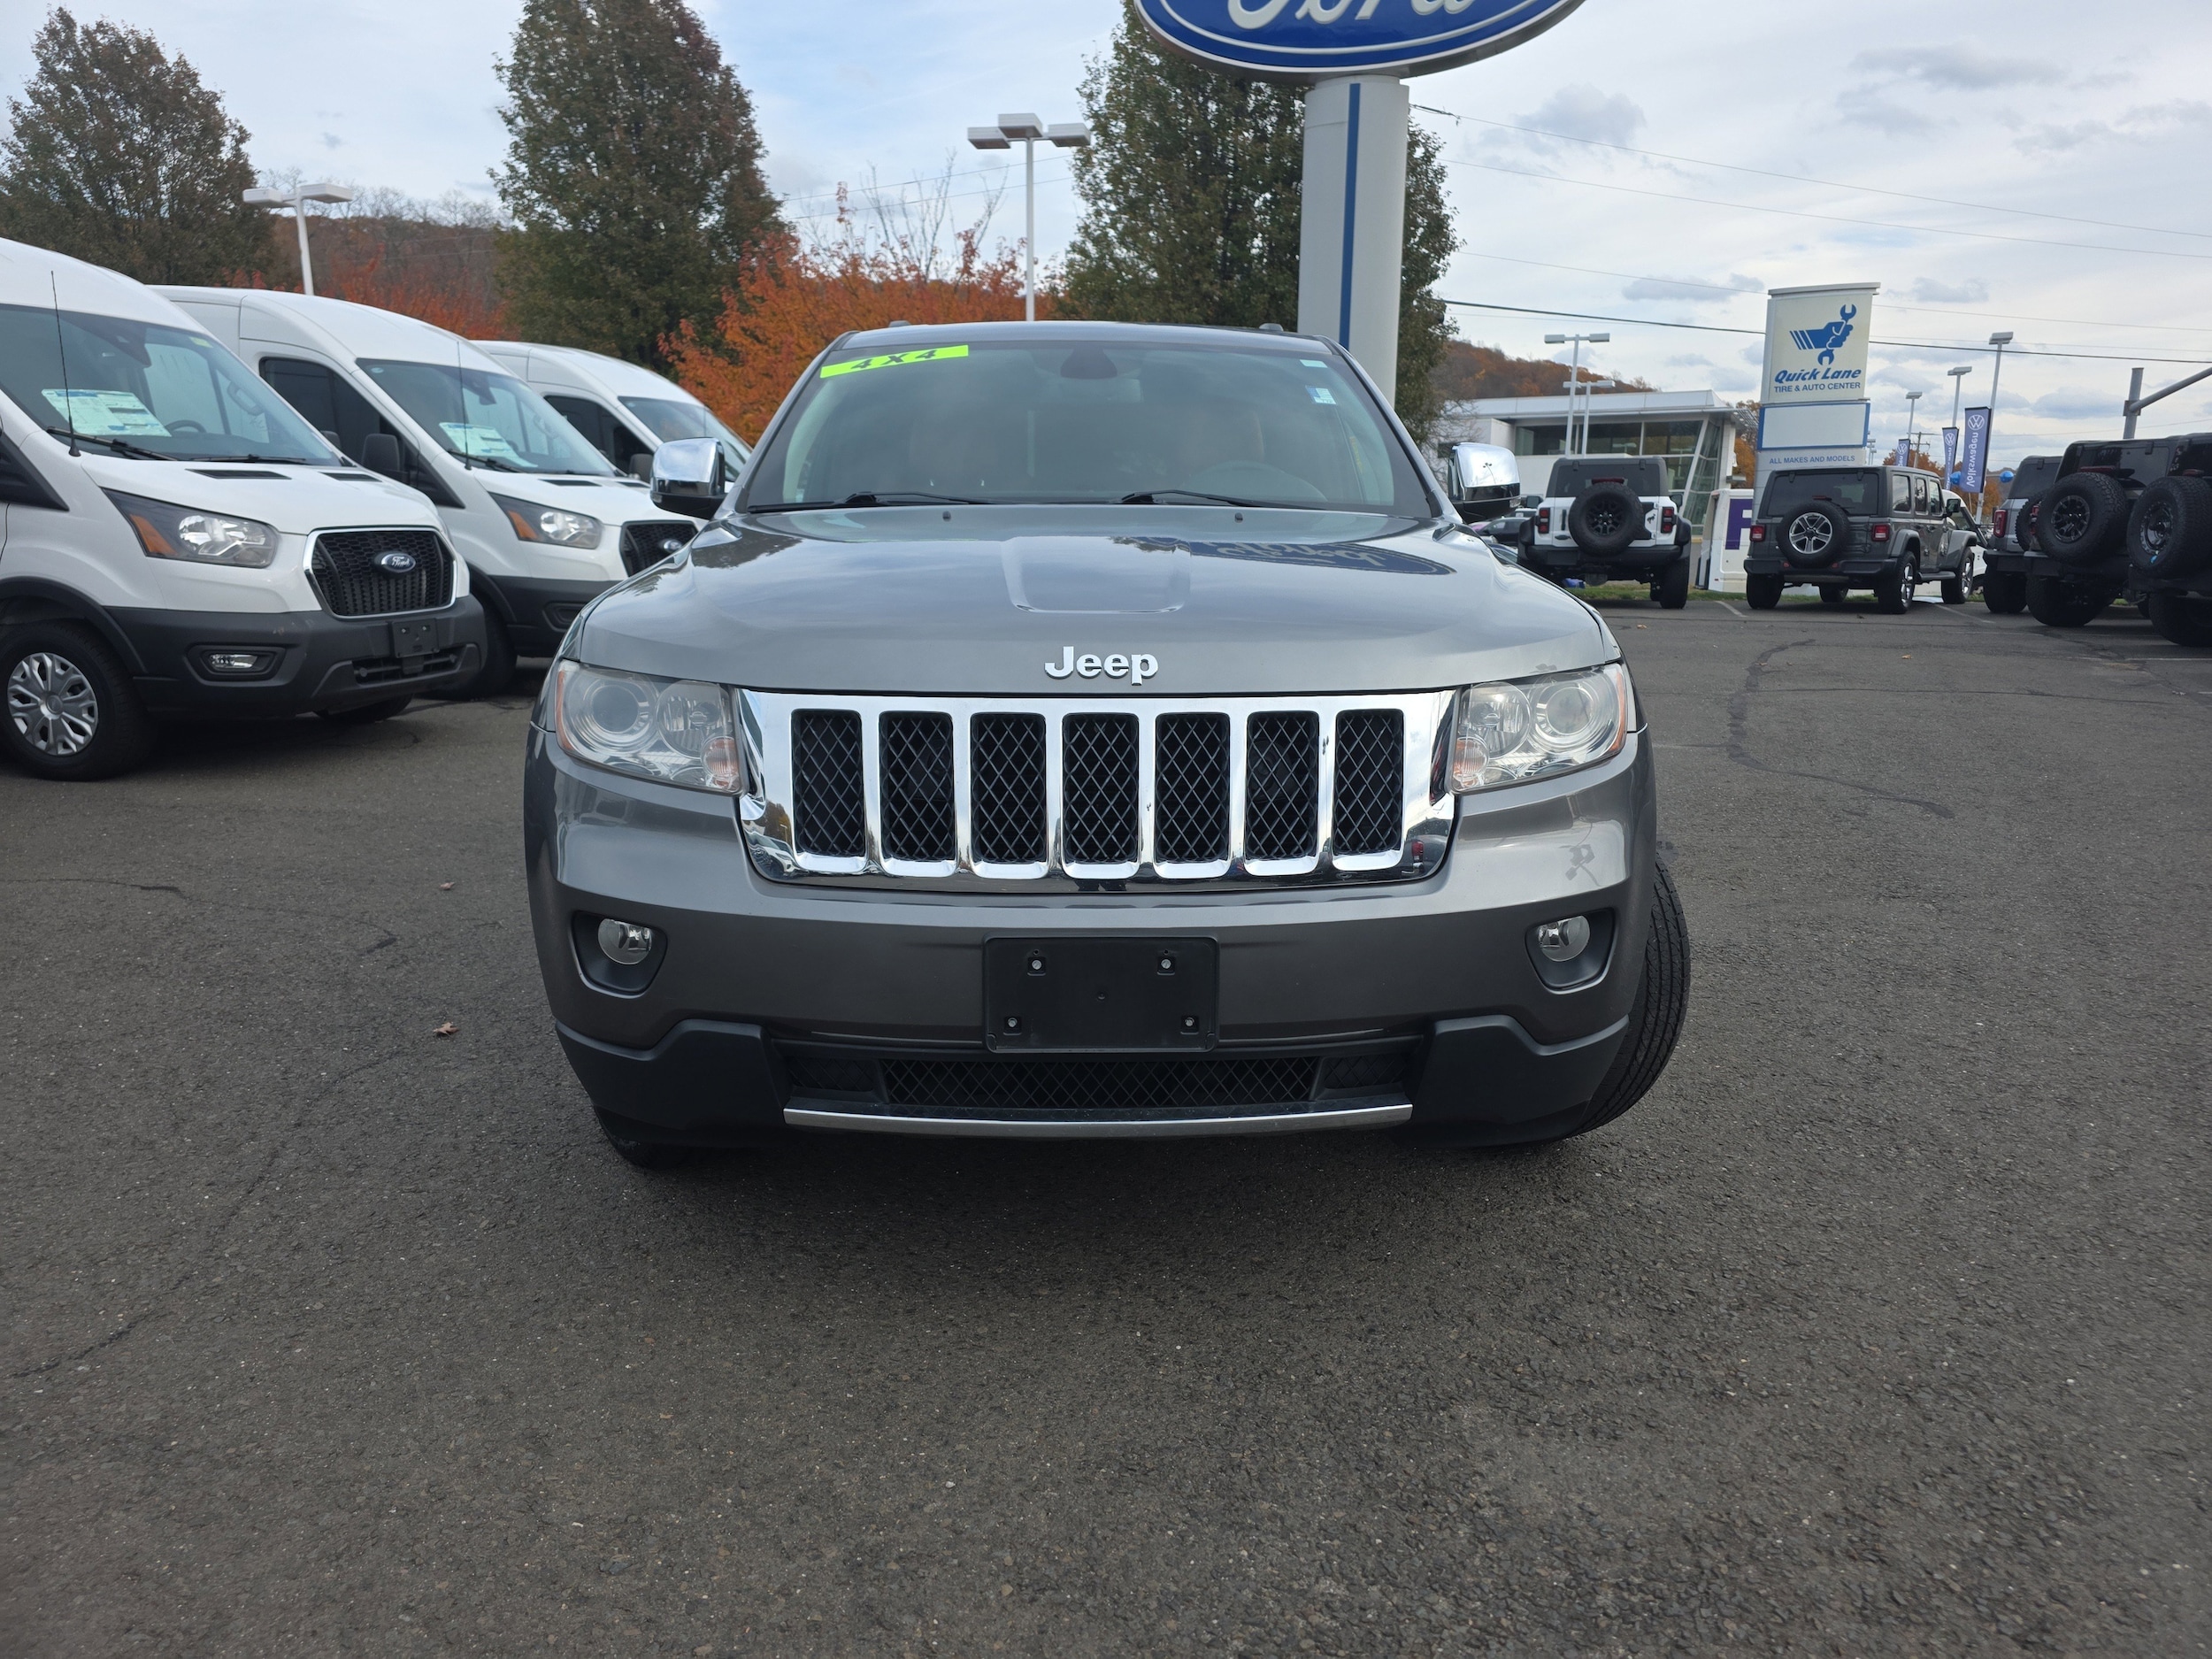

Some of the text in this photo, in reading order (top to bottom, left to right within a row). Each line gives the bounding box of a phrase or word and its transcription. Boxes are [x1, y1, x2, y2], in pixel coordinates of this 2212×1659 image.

[1774, 367, 1862, 383] Quick Lane
[1801, 383, 1825, 392] AUTO
[1827, 381, 1861, 390] CENTER
[1044, 645, 1159, 687] Jeep
